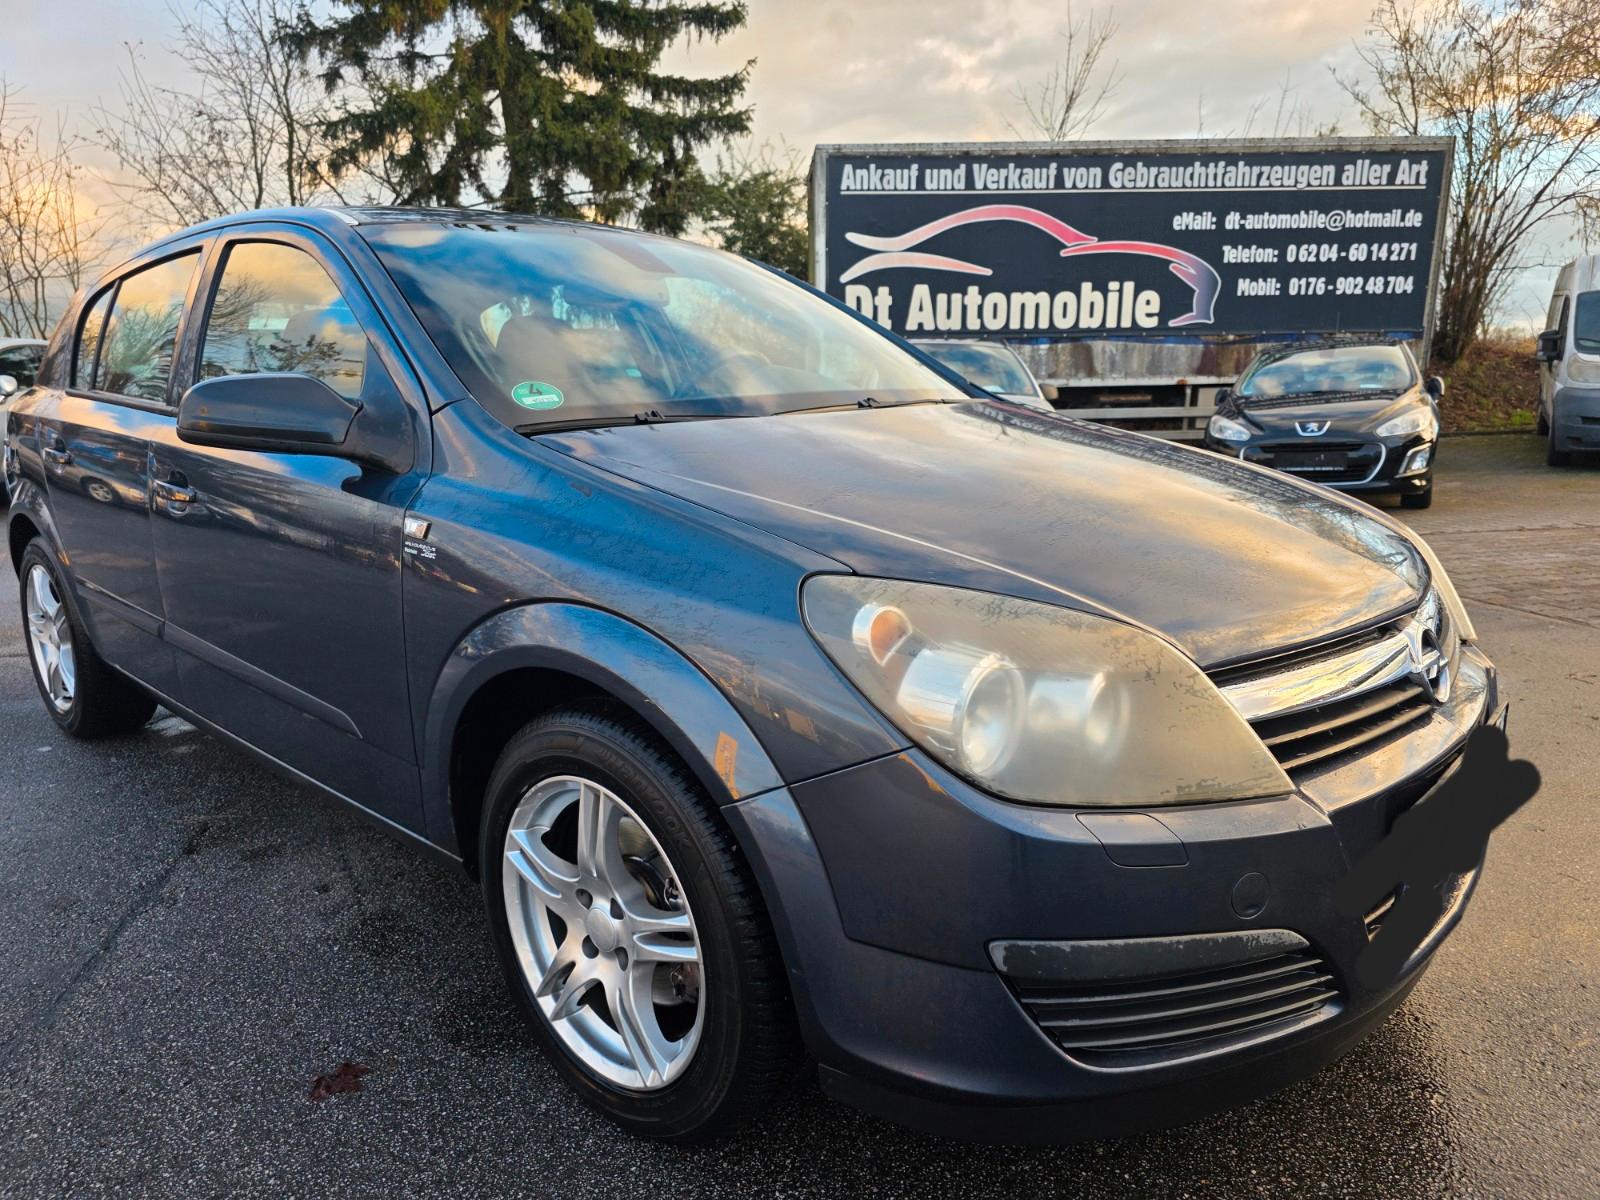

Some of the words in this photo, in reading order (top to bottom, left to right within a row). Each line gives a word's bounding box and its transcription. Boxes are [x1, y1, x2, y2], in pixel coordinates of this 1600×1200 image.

[840, 163, 919, 191] Ankauf
[924, 163, 966, 190] und
[972, 162, 1058, 190] Verkauf
[1062, 166, 1103, 189] von
[1108, 160, 1336, 190] Gebrauchtfahrzeugen
[1341, 160, 1391, 186] aller
[1395, 159, 1429, 186] Art
[1172, 211, 1217, 231] eMail:
[1225, 209, 1423, 232] dt-automobile@hotmail.de
[1222, 244, 1279, 263] Telefon:
[1237, 277, 1281, 296] Mobil:
[845, 284, 893, 331] Dt
[905, 281, 1161, 331] Automobile
